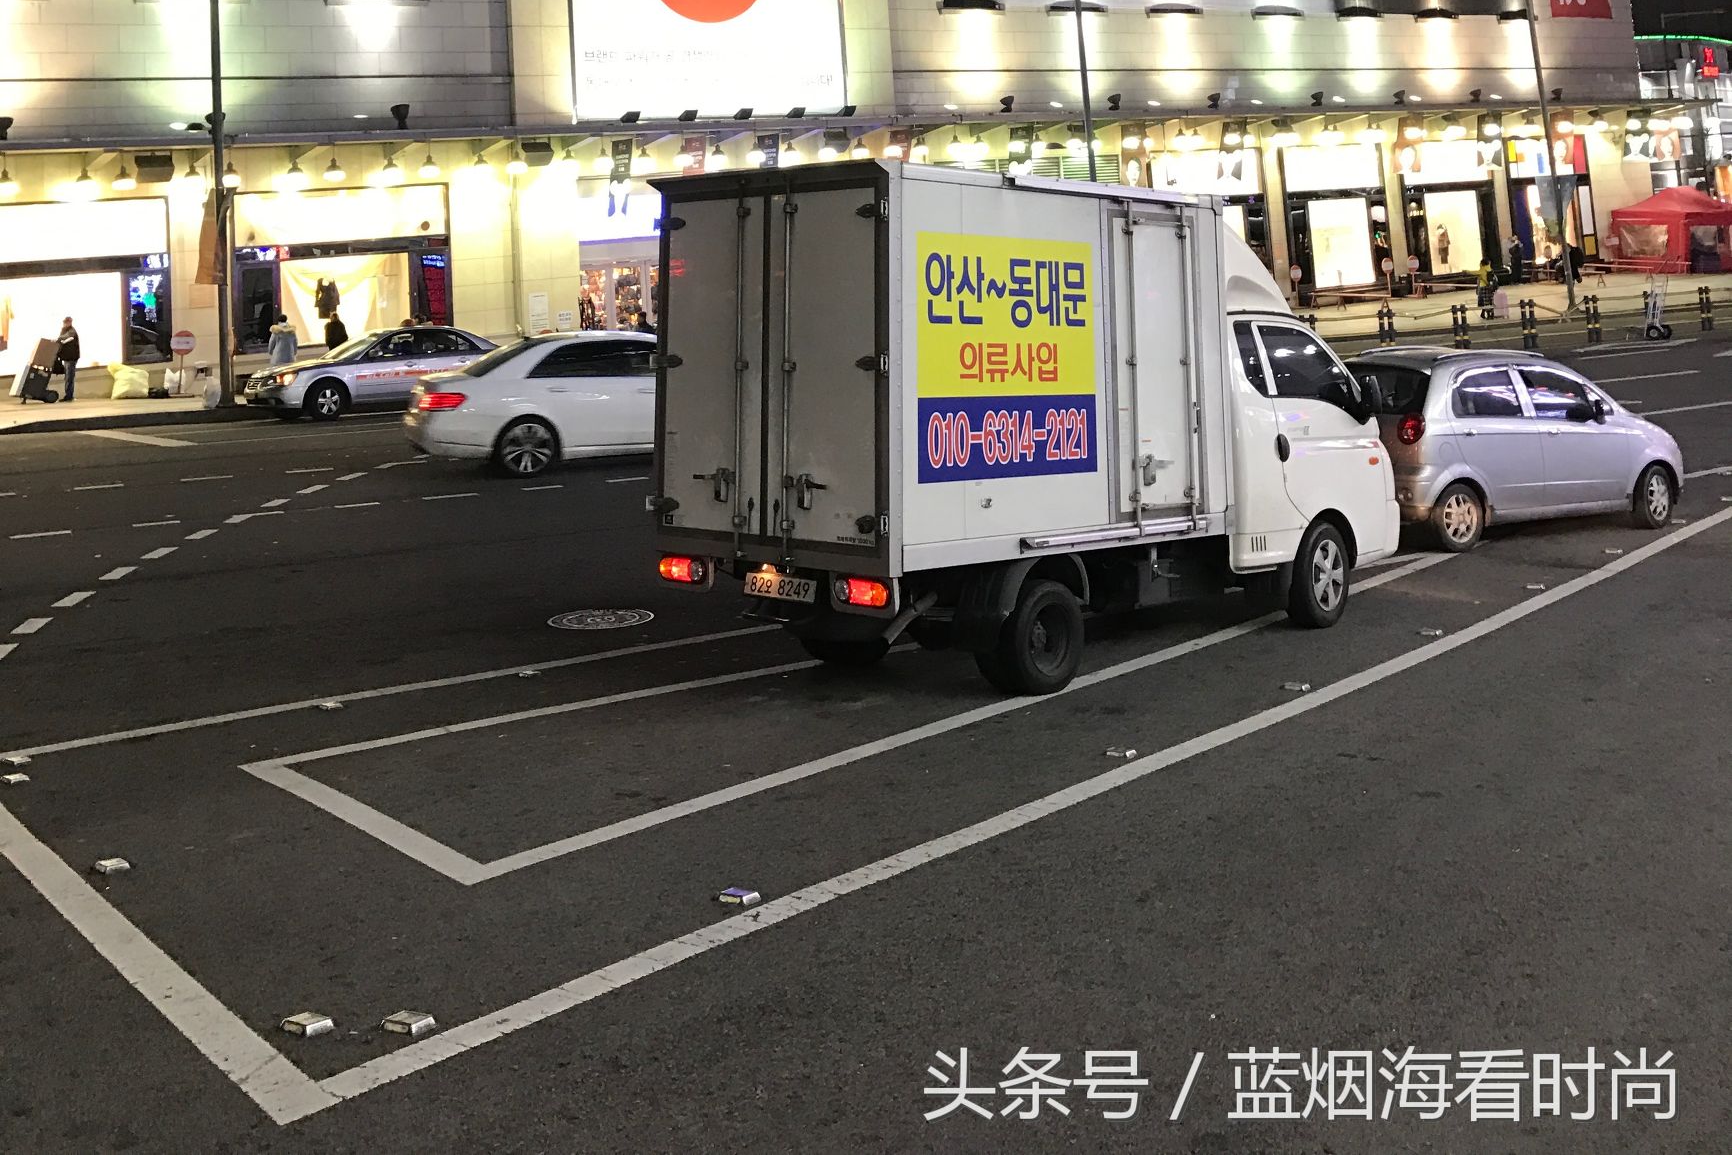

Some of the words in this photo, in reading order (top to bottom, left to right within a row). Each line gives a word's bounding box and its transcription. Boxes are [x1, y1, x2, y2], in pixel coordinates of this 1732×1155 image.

[925, 252, 1087, 329] 안산~동대문
[959, 342, 1059, 383] 의류사입
[927, 407, 1088, 469] 010-6314-2121
[777, 579, 810, 599] 8249
